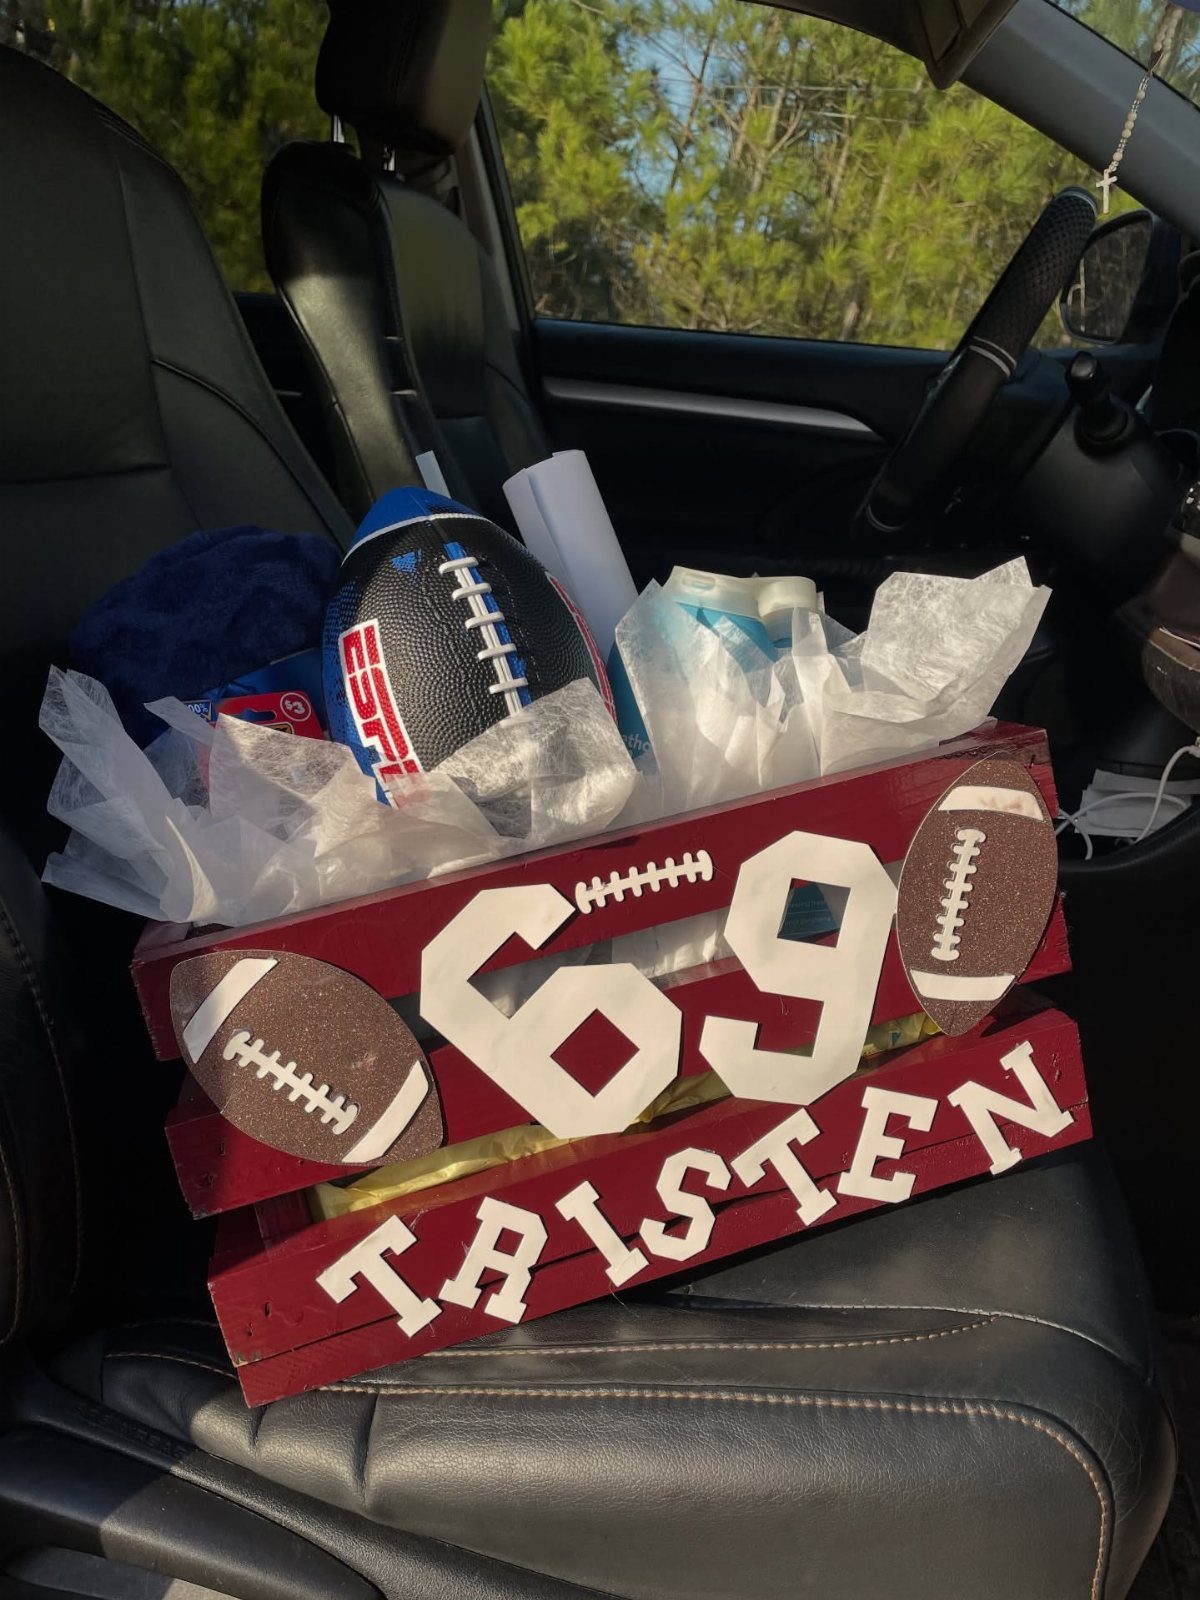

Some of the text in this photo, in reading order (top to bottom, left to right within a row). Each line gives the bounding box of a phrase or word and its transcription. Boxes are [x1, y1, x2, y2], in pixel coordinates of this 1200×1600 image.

[284, 700, 305, 714] $3
[419, 830, 900, 1139] 69
[315, 1040, 1074, 1338] TRISTEN
